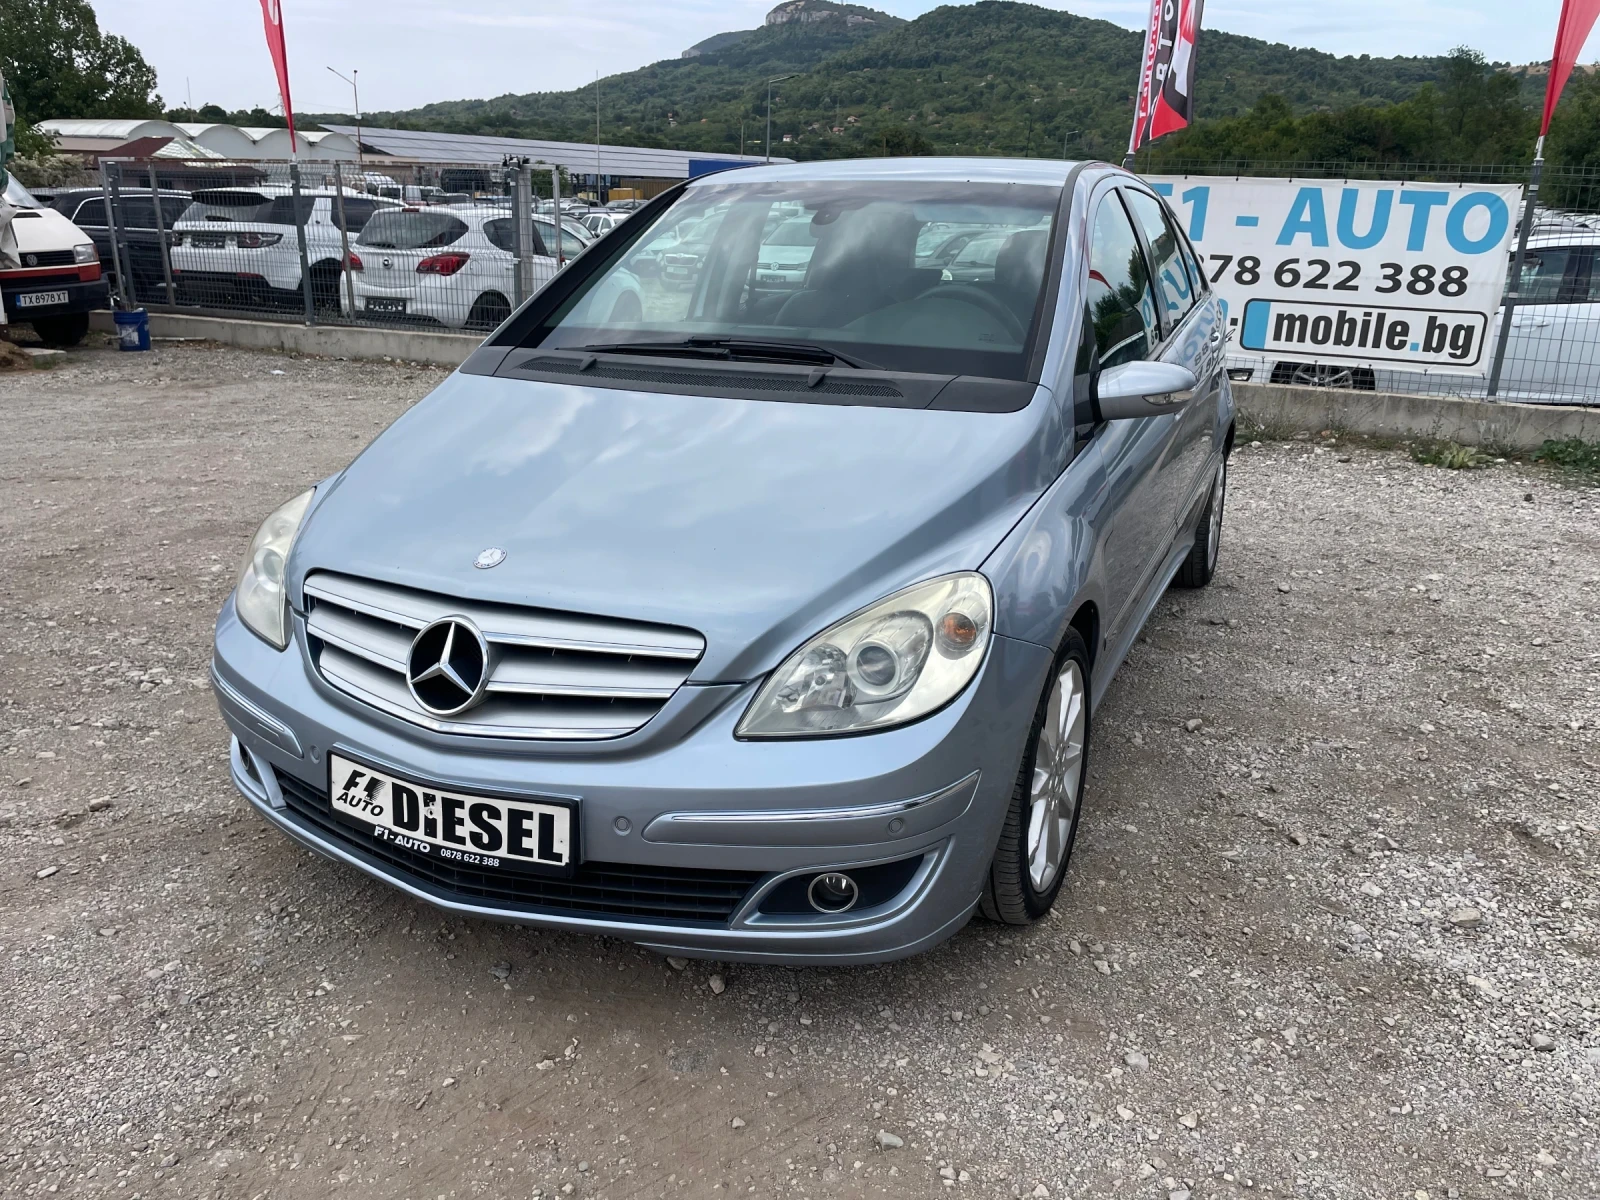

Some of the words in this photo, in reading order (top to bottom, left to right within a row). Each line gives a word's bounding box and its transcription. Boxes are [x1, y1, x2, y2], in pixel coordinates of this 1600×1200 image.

[1275, 187, 1509, 255] AUTO
[1198, 254, 1261, 286] 78
[1274, 258, 1361, 292] 622
[1375, 262, 1469, 297] 388
[36, 294, 55, 304] 8978
[1273, 310, 1476, 360] mobile.bg
[342, 769, 387, 802] F1
[336, 791, 384, 817] AUTO
[374, 826, 431, 853] F1-AUTO
[440, 848, 462, 860] 0878
[463, 853, 480, 864] 622
[482, 857, 500, 867] 388
